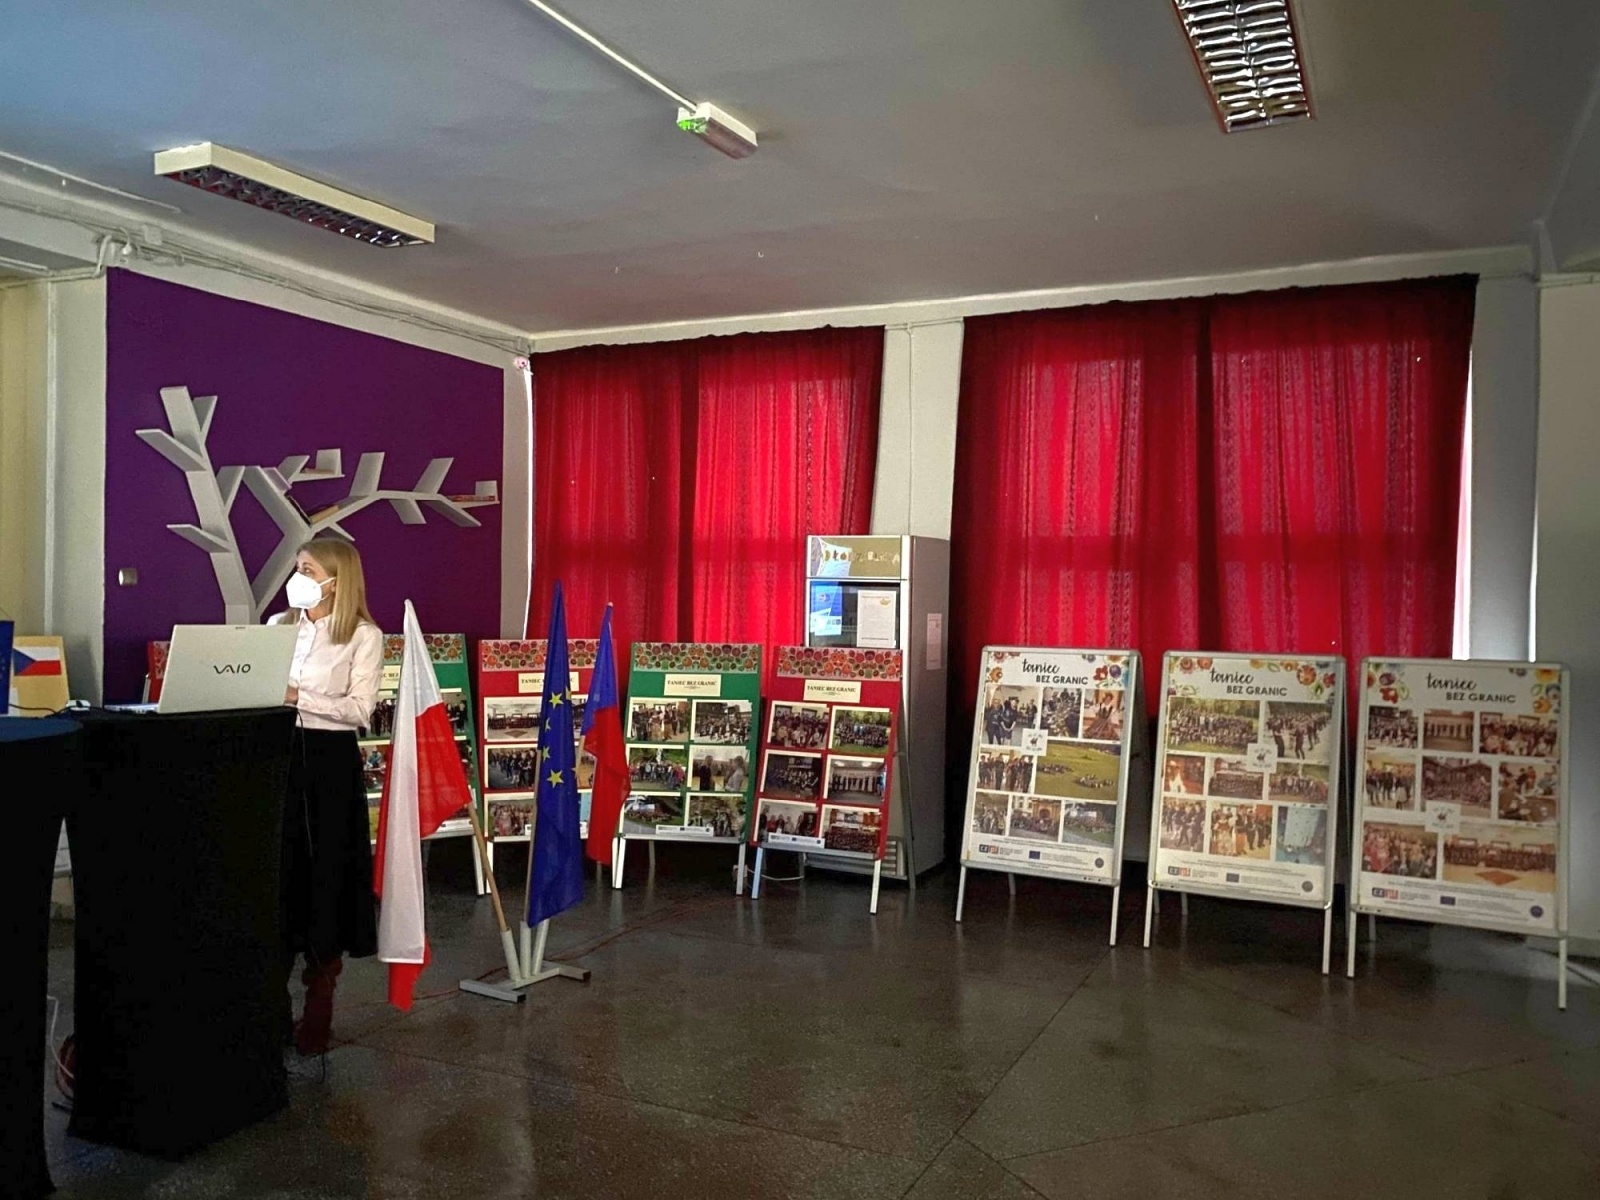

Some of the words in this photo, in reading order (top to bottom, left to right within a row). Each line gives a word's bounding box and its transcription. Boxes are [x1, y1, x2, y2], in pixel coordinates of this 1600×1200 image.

[213, 663, 251, 674] VAIO
[1035, 675, 1051, 683] BEZ
[1052, 675, 1089, 685] GRANIC
[1226, 685, 1244, 694] BEZ
[1245, 686, 1288, 696] GRANIC
[1446, 691, 1466, 701] BEZ
[1468, 693, 1517, 703] GRANIC
